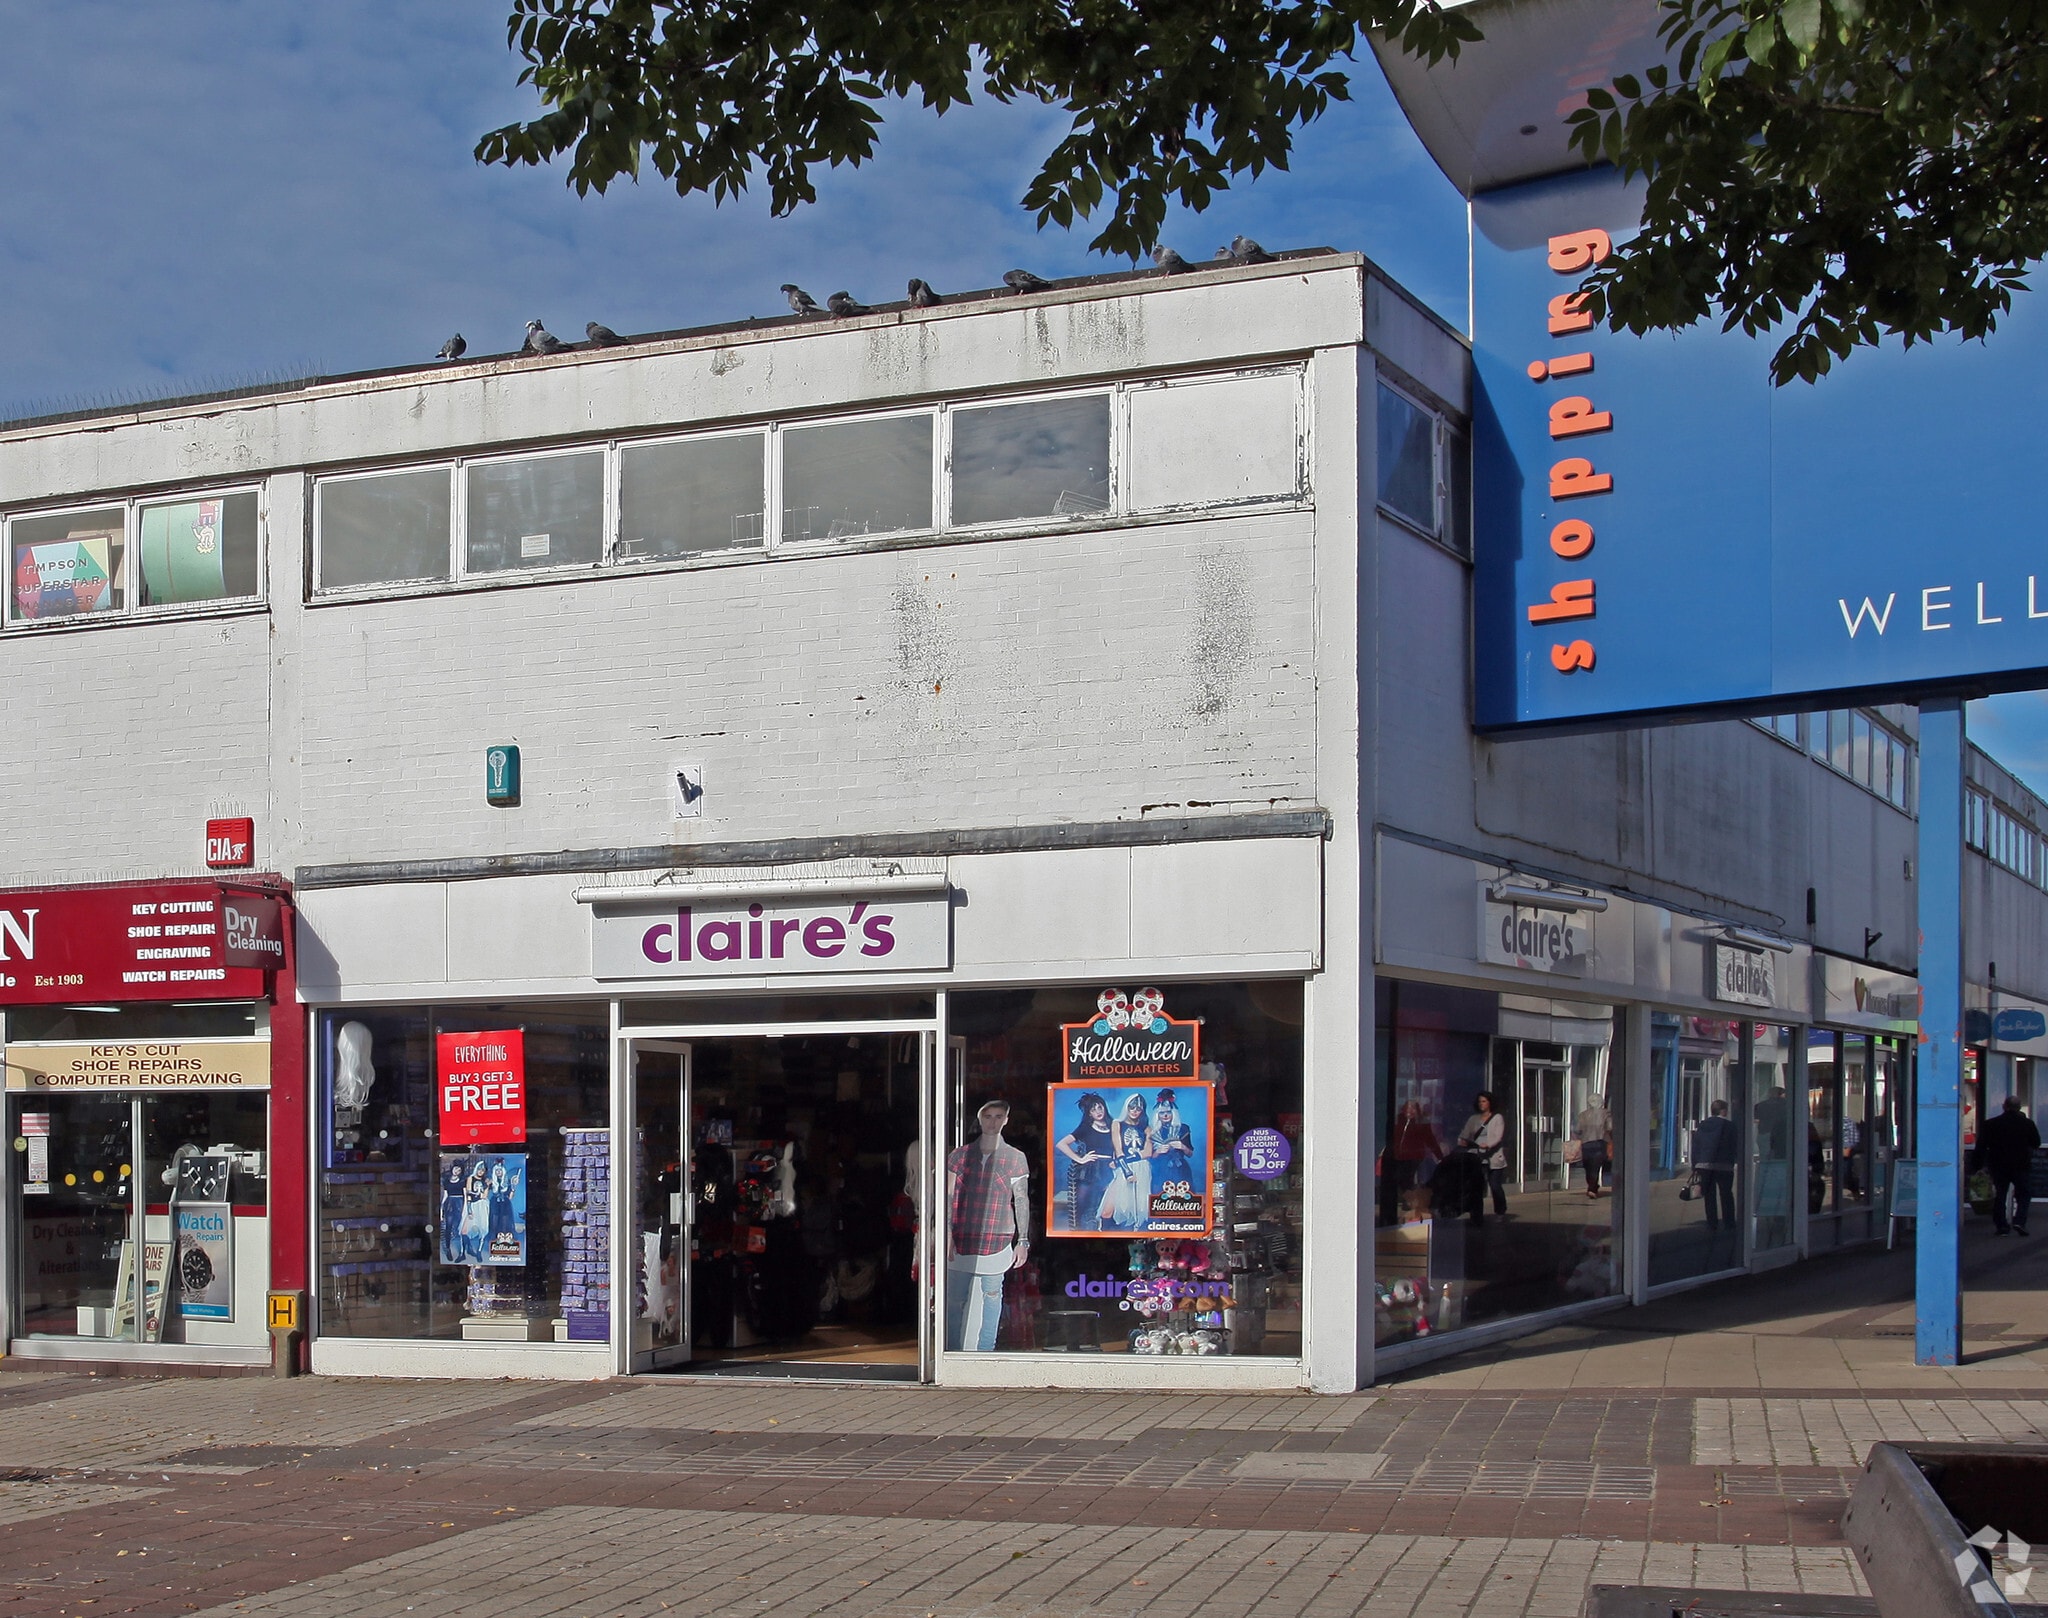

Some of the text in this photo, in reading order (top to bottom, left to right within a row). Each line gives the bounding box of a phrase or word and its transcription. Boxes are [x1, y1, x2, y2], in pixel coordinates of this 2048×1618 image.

[1528, 227, 1613, 672] shopping
[24, 558, 88, 575] TIMPSON
[18, 575, 101, 594] SUPERSTAR
[207, 838, 231, 861] CIA
[132, 901, 214, 915] KEY CUTTING
[225, 907, 258, 938] Dry
[641, 901, 895, 962] claire's
[1501, 900, 1574, 961] claire's
[128, 926, 161, 938] SHOE
[227, 932, 282, 956] Cleaning
[136, 947, 211, 960] ENGRAVING
[35, 975, 54, 986] Est
[57, 974, 84, 985] 1903
[122, 968, 226, 983] WATCH REPAIRS
[1725, 950, 1769, 998] claire's
[90, 1045, 181, 1057] KEYS CUT
[455, 1044, 507, 1063] EVERYTHING
[1070, 1036, 1191, 1063] Halloween
[71, 1059, 202, 1071] SHOE REPAIRS
[1080, 1064, 1180, 1075] HEADQUARTERS
[34, 1073, 242, 1086] COMPUTER ENGRAVING
[449, 1071, 513, 1083] BUY 3 GET 3
[444, 1083, 521, 1112] FREE
[1266, 1161, 1286, 1169] OFF
[176, 1212, 224, 1231] Watch
[1147, 1221, 1205, 1231] claires.com
[196, 1232, 225, 1242] Repairs
[1065, 1274, 1230, 1298] claires.com
[273, 1299, 292, 1323] H
